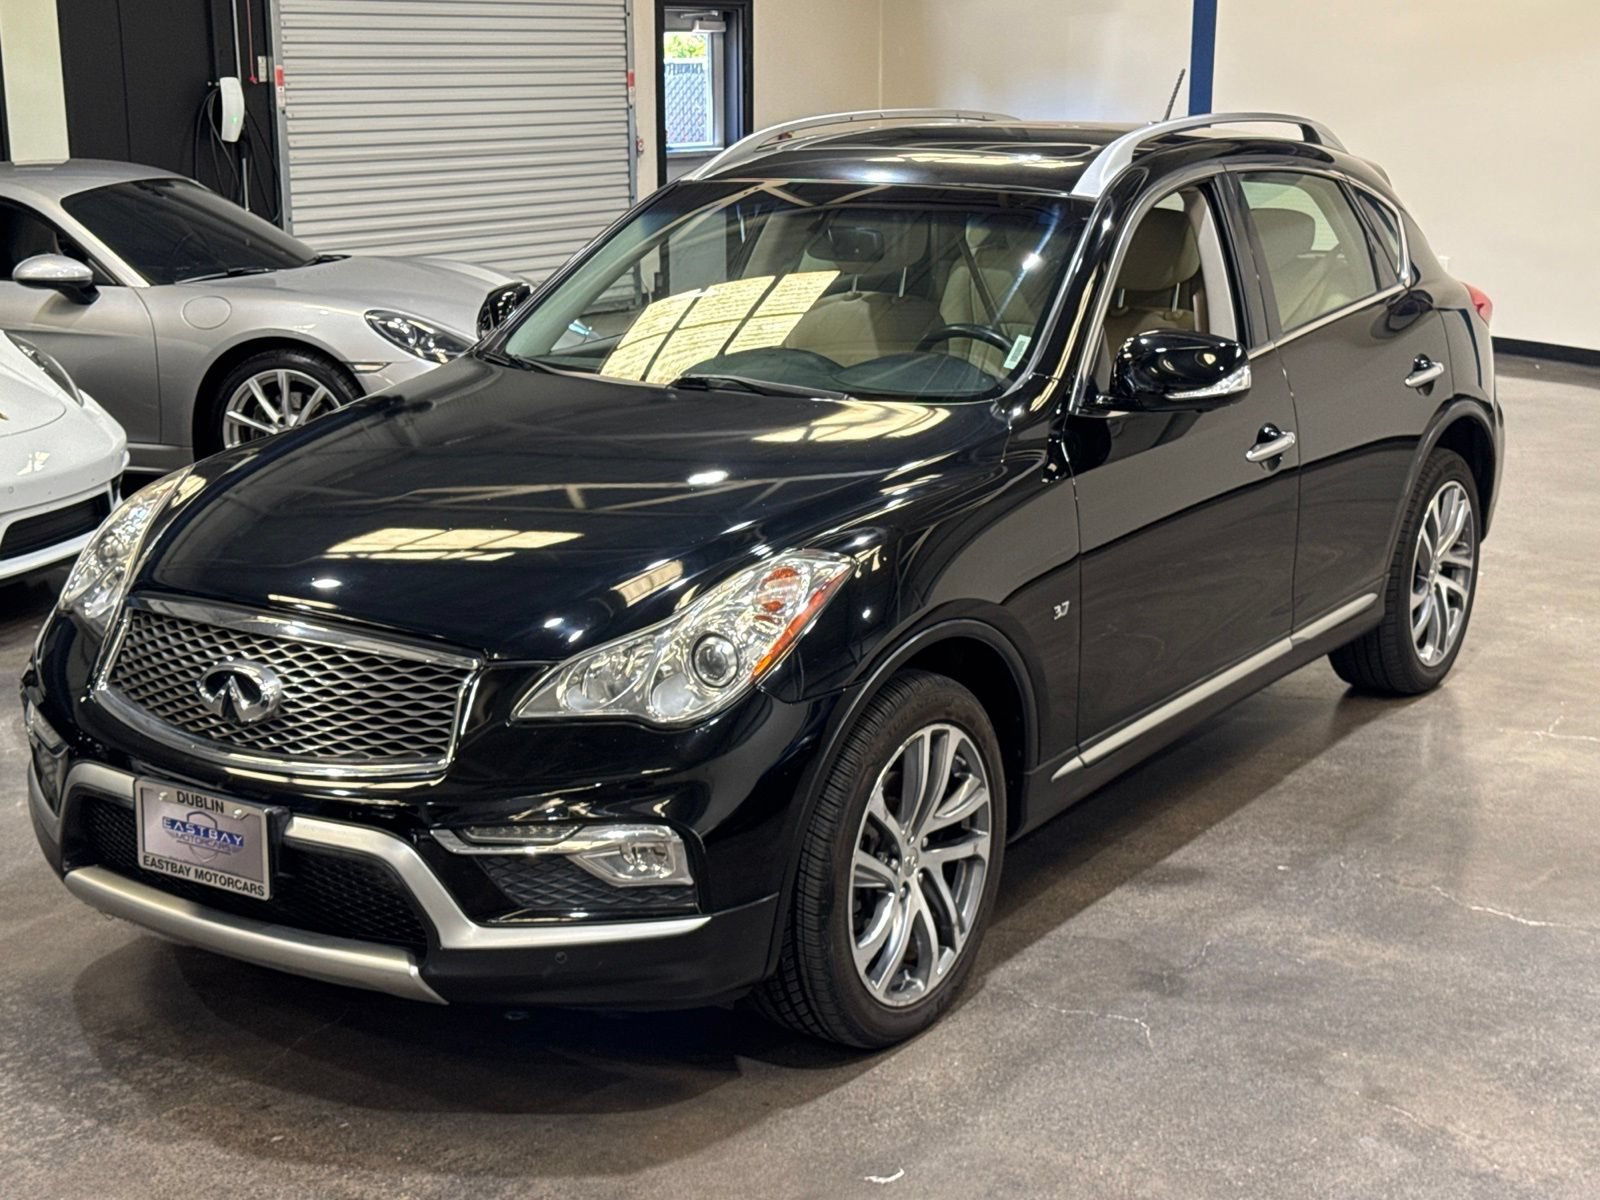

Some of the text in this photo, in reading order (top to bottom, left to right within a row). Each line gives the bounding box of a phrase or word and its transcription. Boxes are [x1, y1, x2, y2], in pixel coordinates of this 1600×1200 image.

[176, 790, 224, 814] DUBLIN
[163, 818, 243, 846] EASTBAY
[143, 855, 265, 897] EASTBAY MOTORCARS
